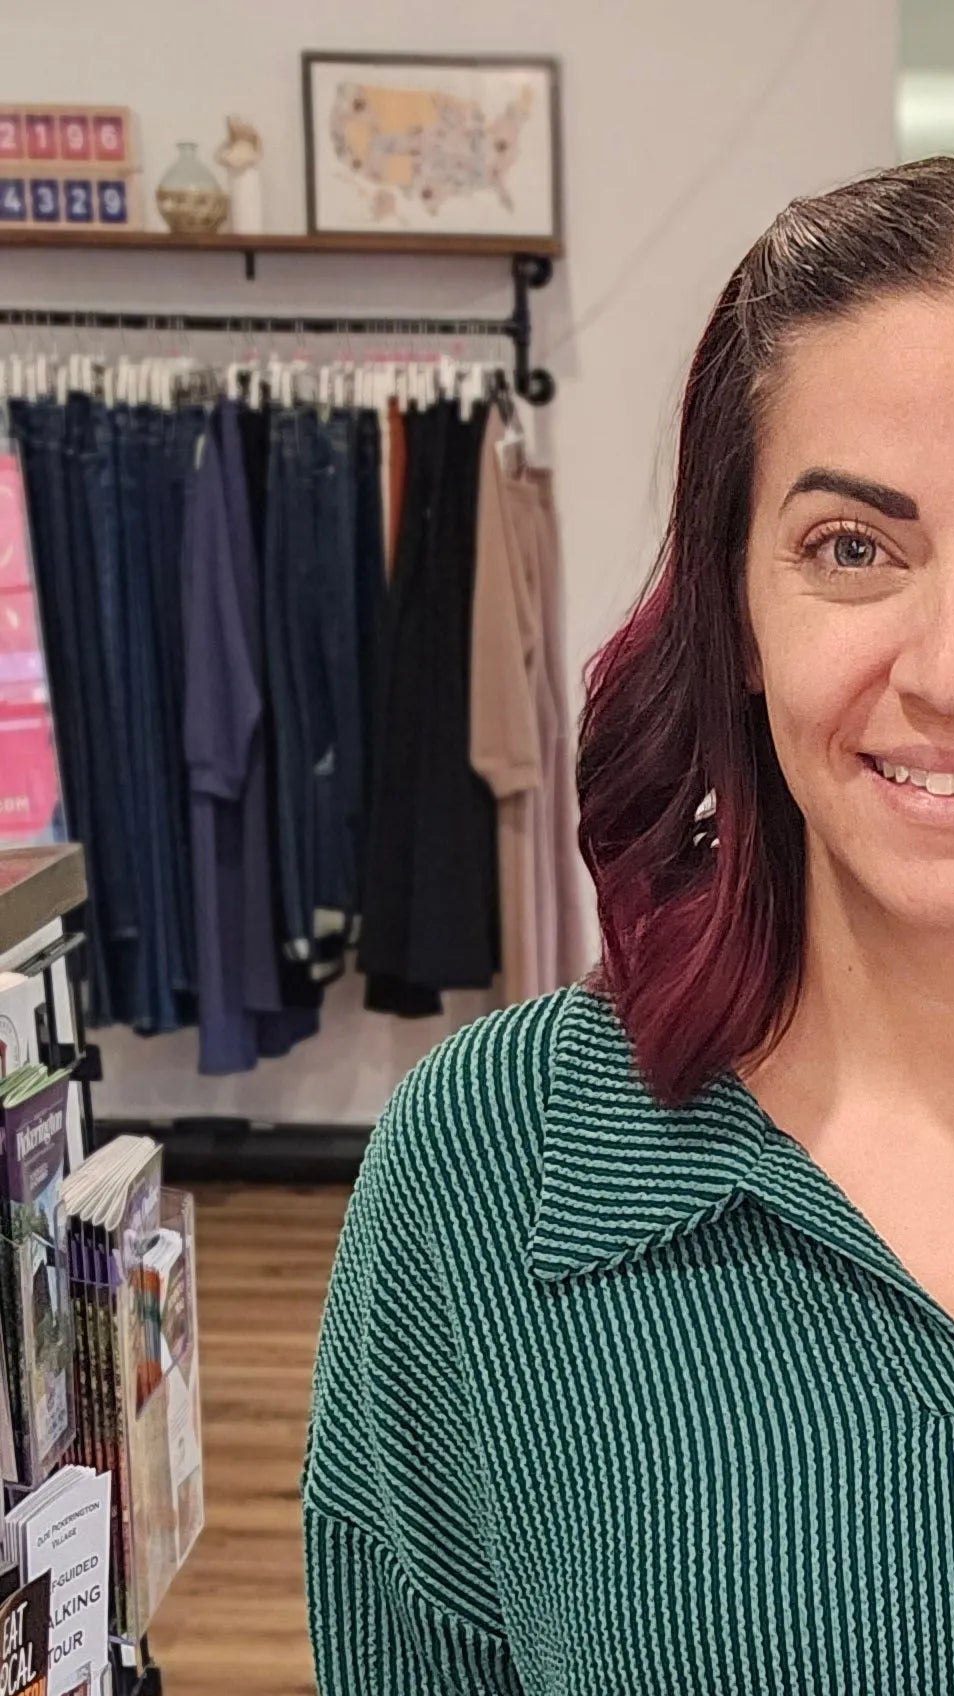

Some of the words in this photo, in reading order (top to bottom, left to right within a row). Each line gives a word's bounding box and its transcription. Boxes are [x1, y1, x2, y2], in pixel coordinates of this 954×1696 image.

[37, 1530, 50, 1548] OLDE
[51, 1501, 100, 1537] PICKERINGTON
[51, 1528, 77, 1549] VILLAGE
[51, 1555, 99, 1593] F-GUIDED
[48, 1585, 101, 1630] ALKING
[3, 1601, 28, 1660] EAT
[48, 1630, 84, 1669] TOUR
